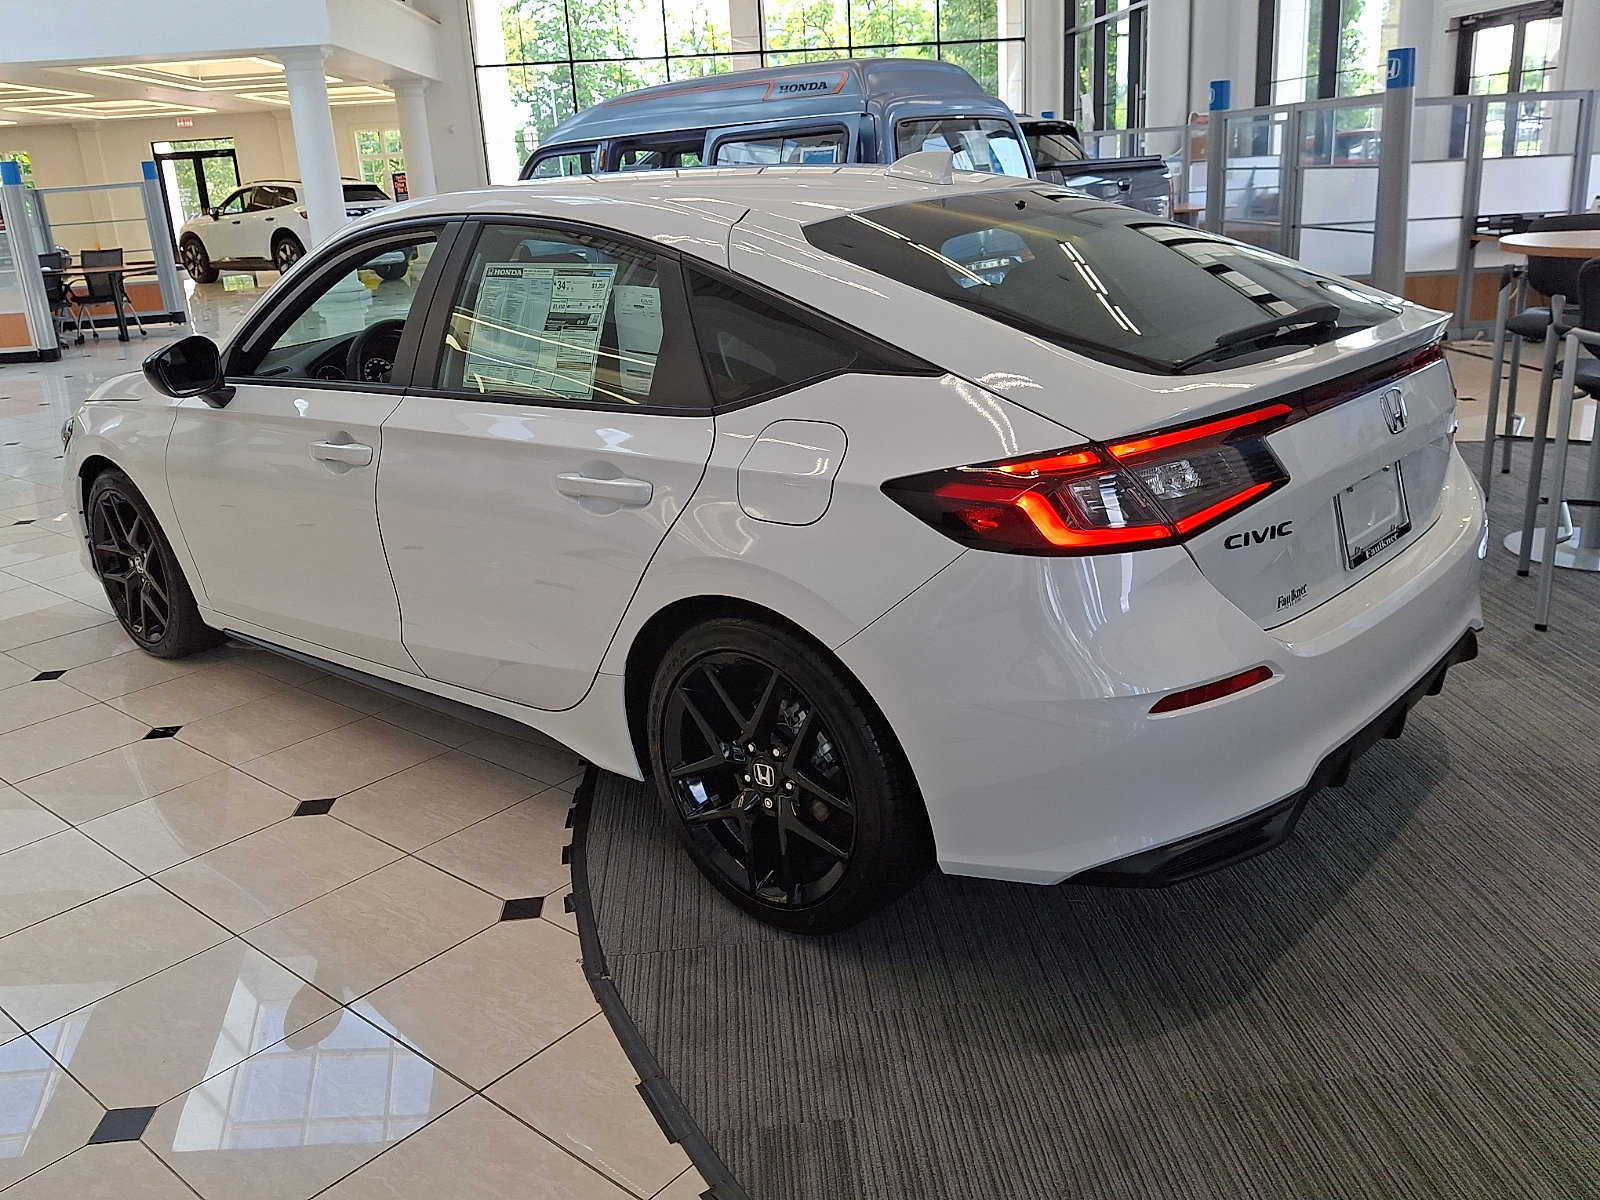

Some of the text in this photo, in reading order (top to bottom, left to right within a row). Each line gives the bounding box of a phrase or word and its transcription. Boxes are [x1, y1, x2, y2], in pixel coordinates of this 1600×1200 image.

[779, 82, 828, 93] HONDA
[493, 268, 523, 276] HONDA
[1224, 520, 1293, 550] CIVIC
[1365, 532, 1399, 560] Faulkner
[1277, 584, 1307, 609] Faulkner
